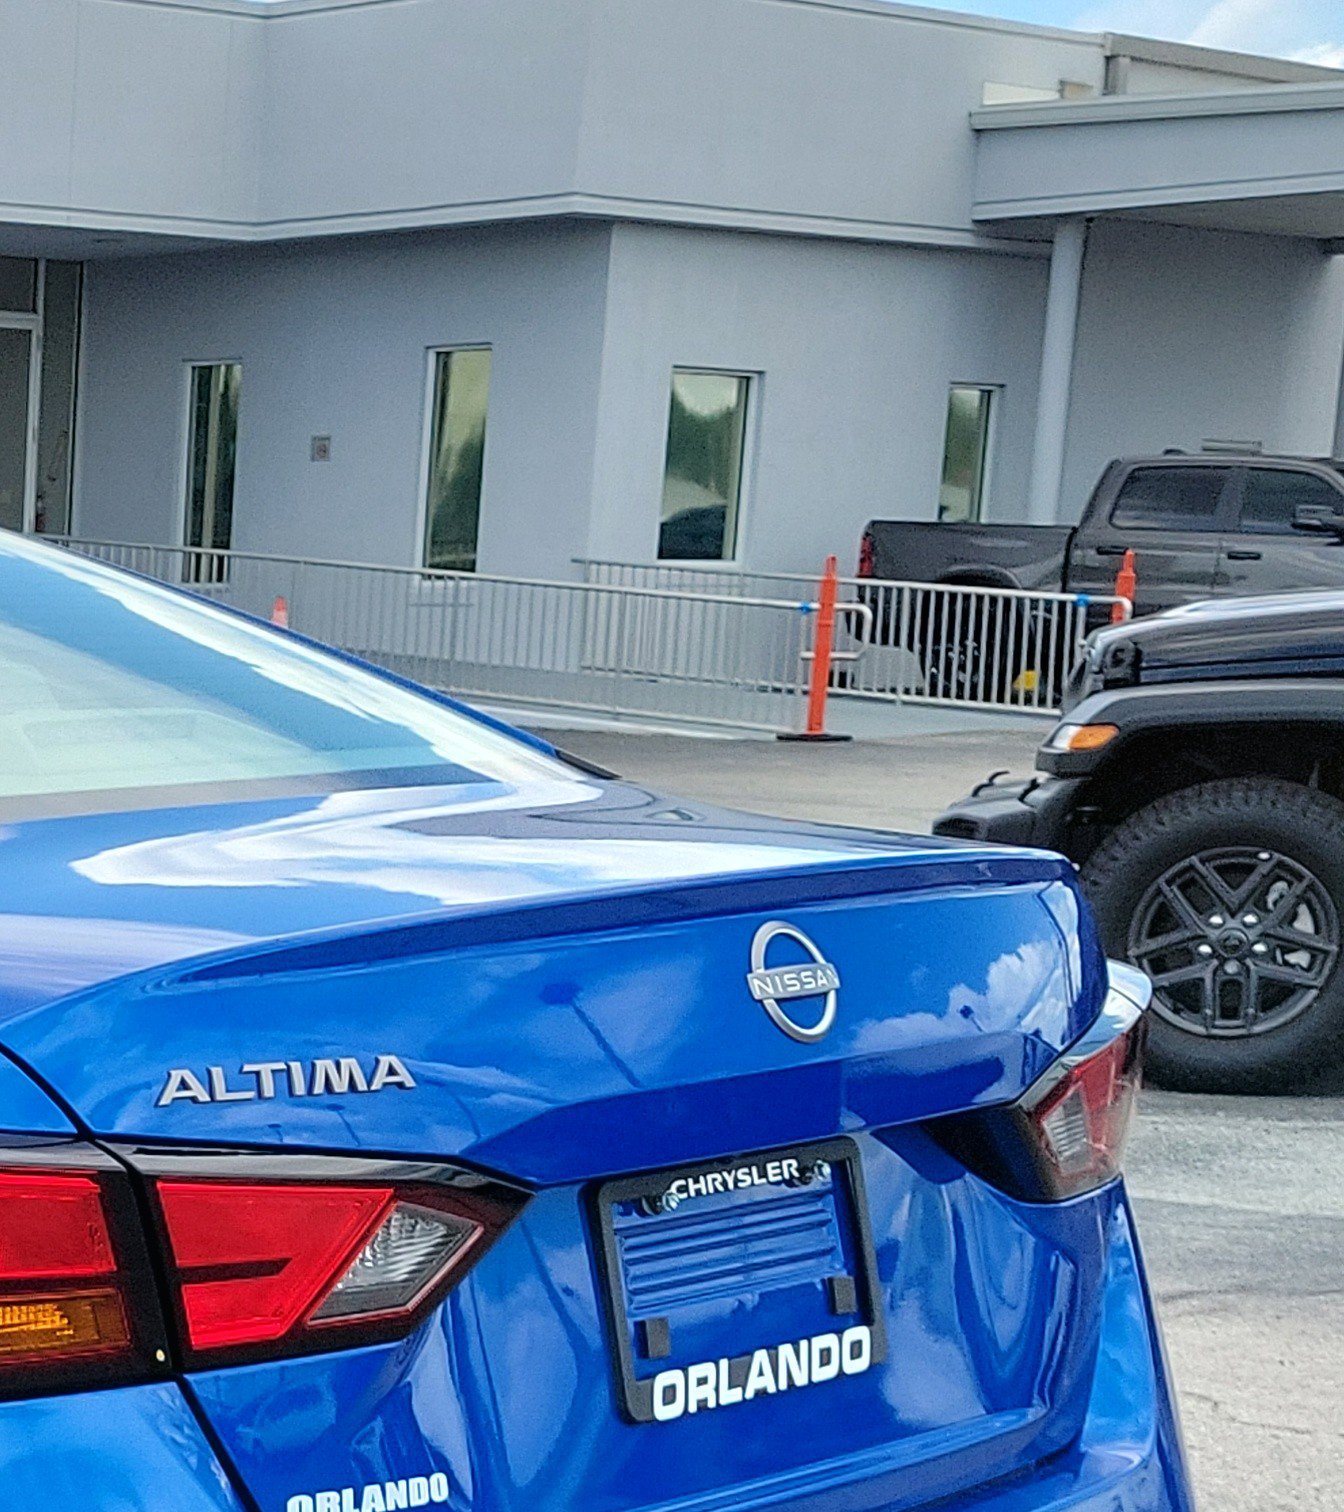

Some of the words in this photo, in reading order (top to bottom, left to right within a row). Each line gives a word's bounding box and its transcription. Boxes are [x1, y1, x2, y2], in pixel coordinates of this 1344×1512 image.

[752, 969, 839, 995] NISSAN
[154, 1055, 417, 1107] ALTIMA
[668, 1158, 800, 1200] CHRYSLER
[653, 1325, 871, 1421] ORLANDO
